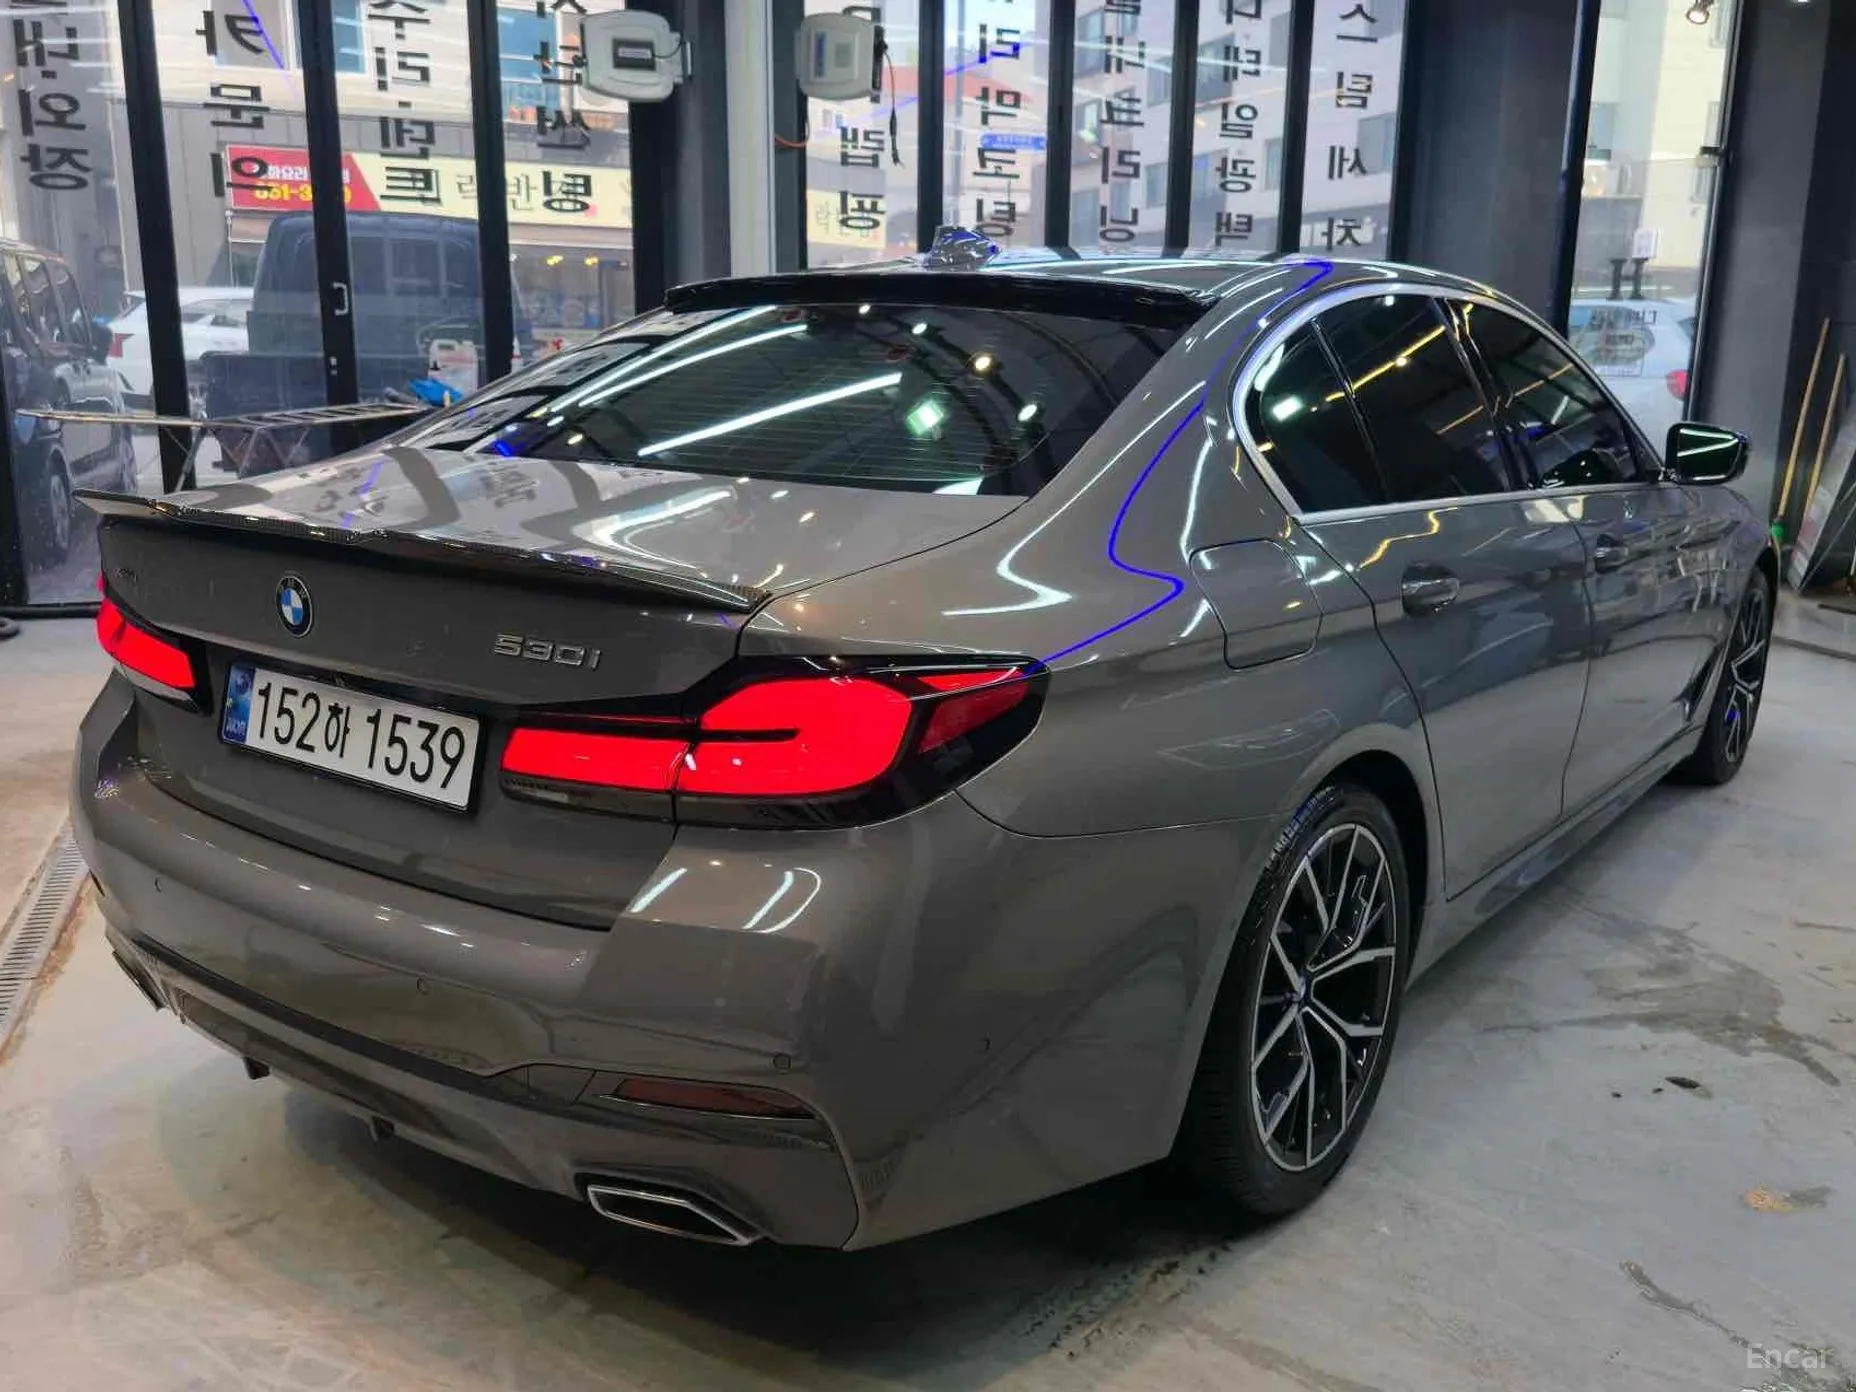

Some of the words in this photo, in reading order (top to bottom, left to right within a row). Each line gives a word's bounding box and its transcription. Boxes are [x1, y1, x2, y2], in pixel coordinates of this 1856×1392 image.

[494, 632, 601, 670] 530i
[257, 682, 351, 758] 152하
[366, 708, 466, 789] 1539
